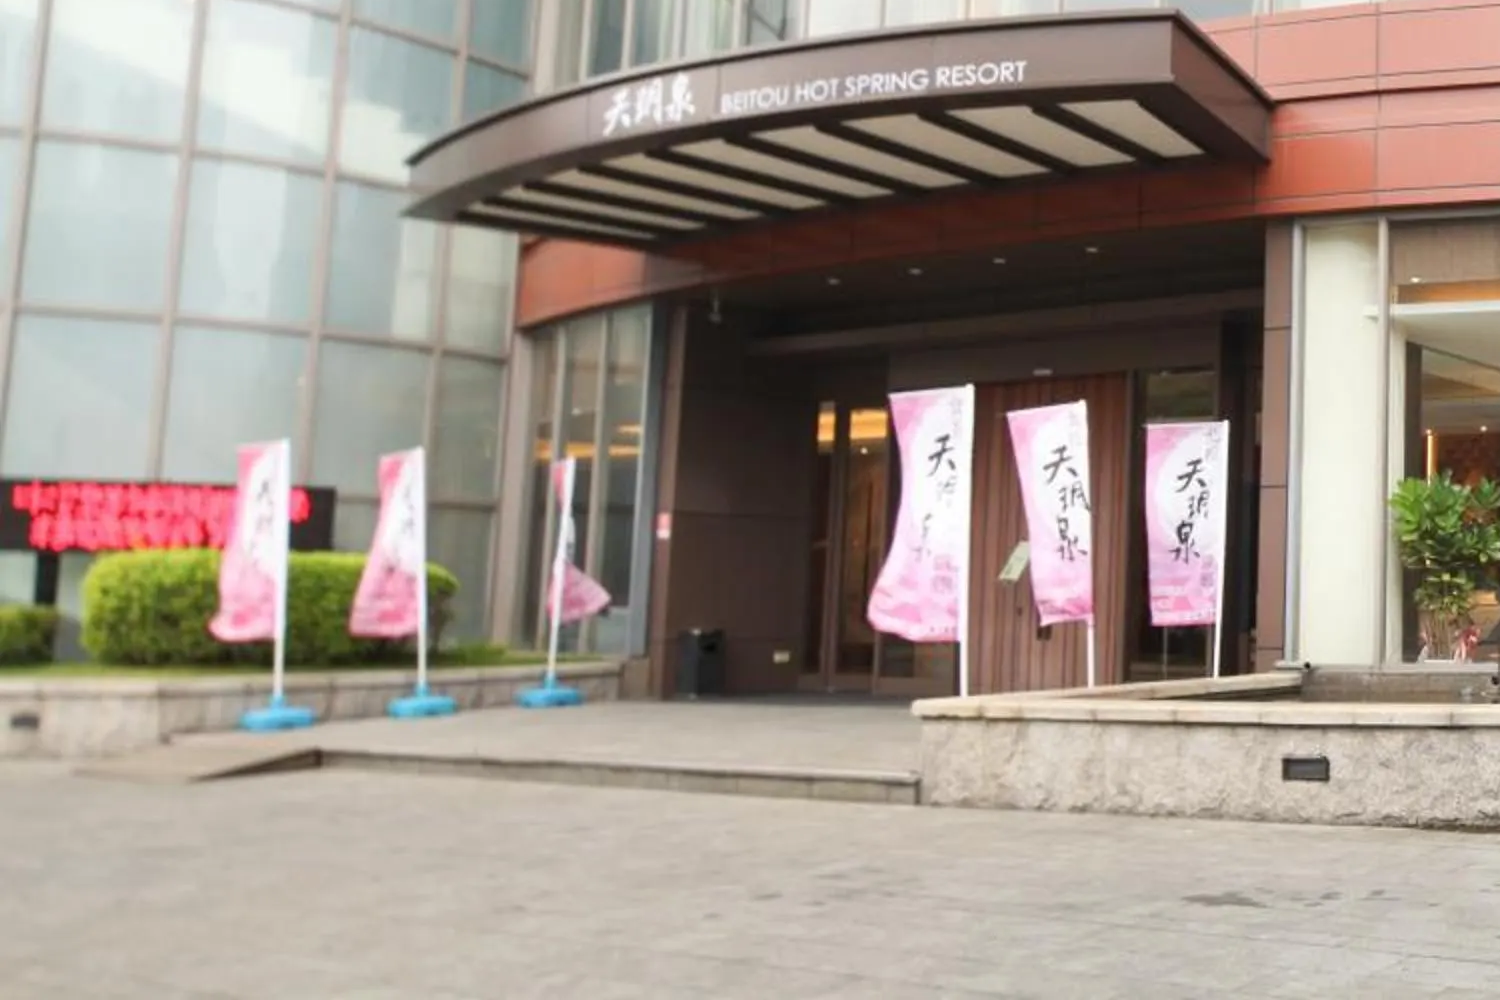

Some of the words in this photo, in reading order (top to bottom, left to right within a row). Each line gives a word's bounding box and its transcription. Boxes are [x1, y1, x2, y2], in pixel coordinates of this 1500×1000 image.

[720, 87, 789, 114] BEITOU
[795, 78, 838, 103] HOT
[844, 68, 928, 97] SPRING
[935, 61, 1027, 87] RESORT
